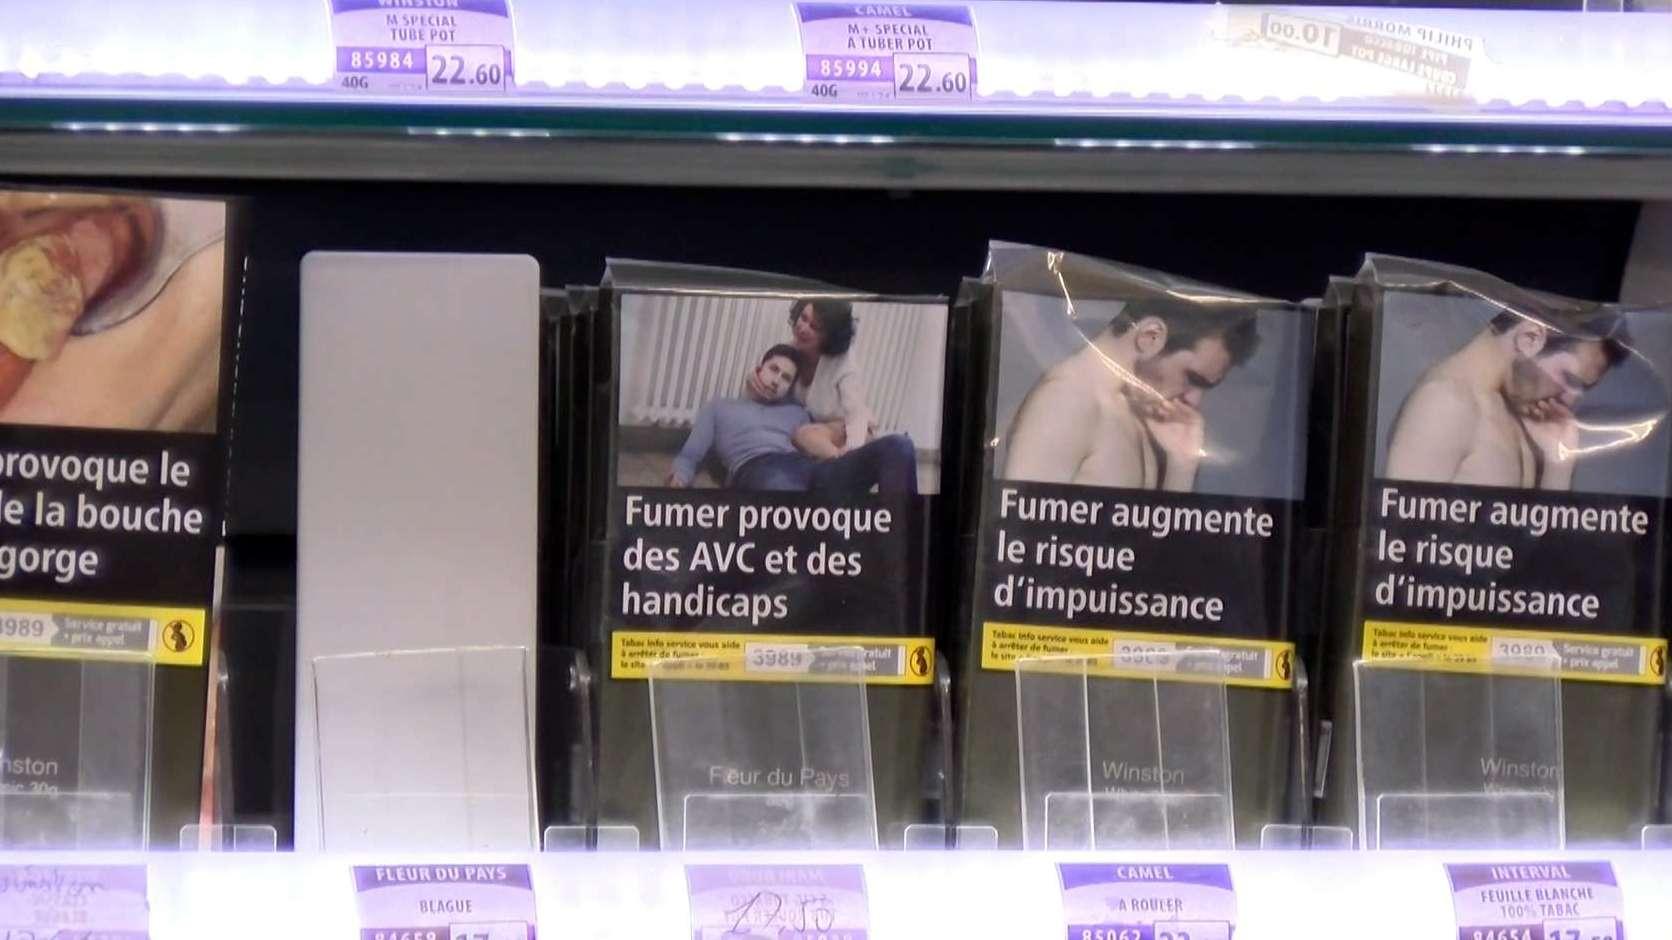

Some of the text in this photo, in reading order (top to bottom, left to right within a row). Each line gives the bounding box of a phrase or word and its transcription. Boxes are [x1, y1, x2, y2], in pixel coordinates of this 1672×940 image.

[855, 5, 912, 17] CAMEL
[386, 14, 457, 27] M SPECIAL
[391, 29, 456, 41] TUBE POT
[875, 24, 928, 36] SPECIAL
[848, 37, 932, 50] A TUBER POT
[351, 52, 413, 68] 85984
[432, 56, 501, 85] 22.60
[821, 60, 881, 77] 85994
[342, 76, 368, 89] 40G
[900, 63, 966, 92] 22.60
[811, 84, 838, 97] 40G
[160, 450, 190, 487] le
[0, 489, 203, 534] e la bouche
[625, 495, 892, 540] Fumer provoque
[1000, 489, 1274, 538] Fumer augmente
[1380, 487, 1649, 537] Fumer augmente
[623, 538, 862, 576] des AVC et des
[997, 530, 1136, 577] le risque
[1378, 529, 1513, 575] le risque
[994, 574, 1224, 621] d'impuissance
[1375, 573, 1600, 618] d'impuissance
[621, 582, 788, 626] handicaps
[667, 639, 696, 649] service
[699, 640, 719, 649] vous
[1037, 633, 1066, 643] service
[1069, 637, 1088, 645] vous
[1102, 760, 1184, 784] Winston
[767, 768, 792, 786] du
[800, 768, 849, 793] Pays
[375, 866, 507, 881] FLEUR DU PAYS
[1116, 866, 1174, 880] CAMEL
[1491, 865, 1571, 880] INTERVAL
[1481, 887, 1594, 903] FEUILLE BLANCHE
[420, 900, 472, 913] BLAGUE
[1118, 899, 1183, 913] A ROULER
[1501, 903, 1579, 918] 100% TABAC
